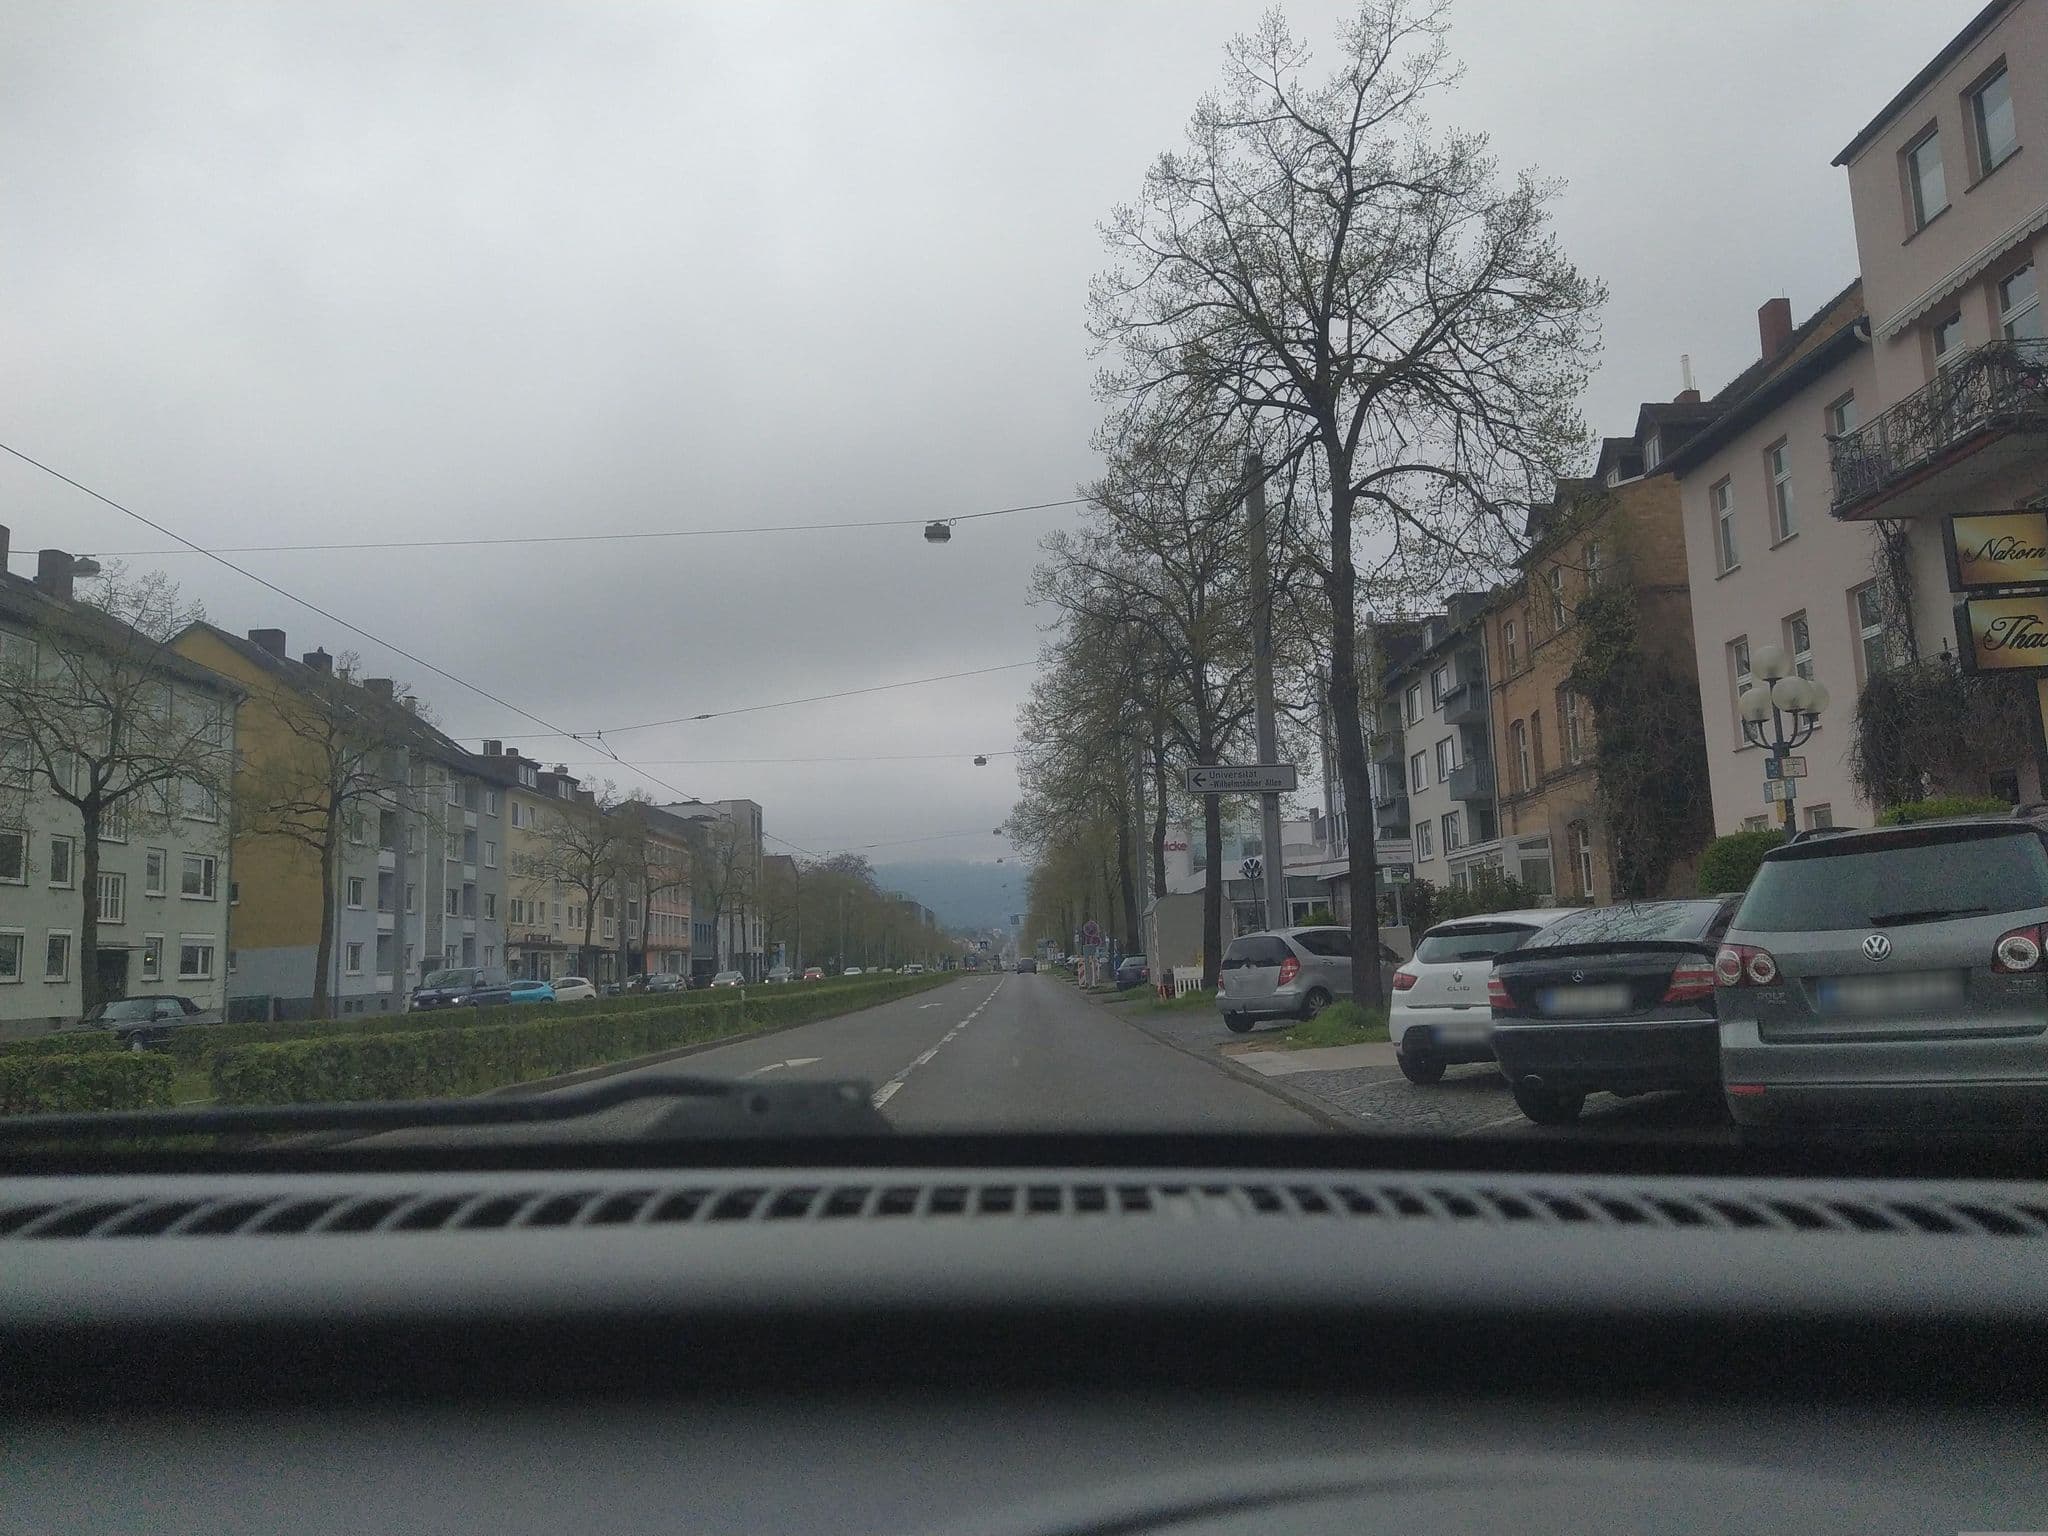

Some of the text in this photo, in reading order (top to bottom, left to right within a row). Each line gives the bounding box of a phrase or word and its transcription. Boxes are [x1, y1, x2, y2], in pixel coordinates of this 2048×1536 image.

[1963, 536, 2047, 563] Nakorn
[1209, 770, 1257, 779] Universität
[1163, 841, 1187, 851] icke
[1863, 935, 1890, 960] VW
